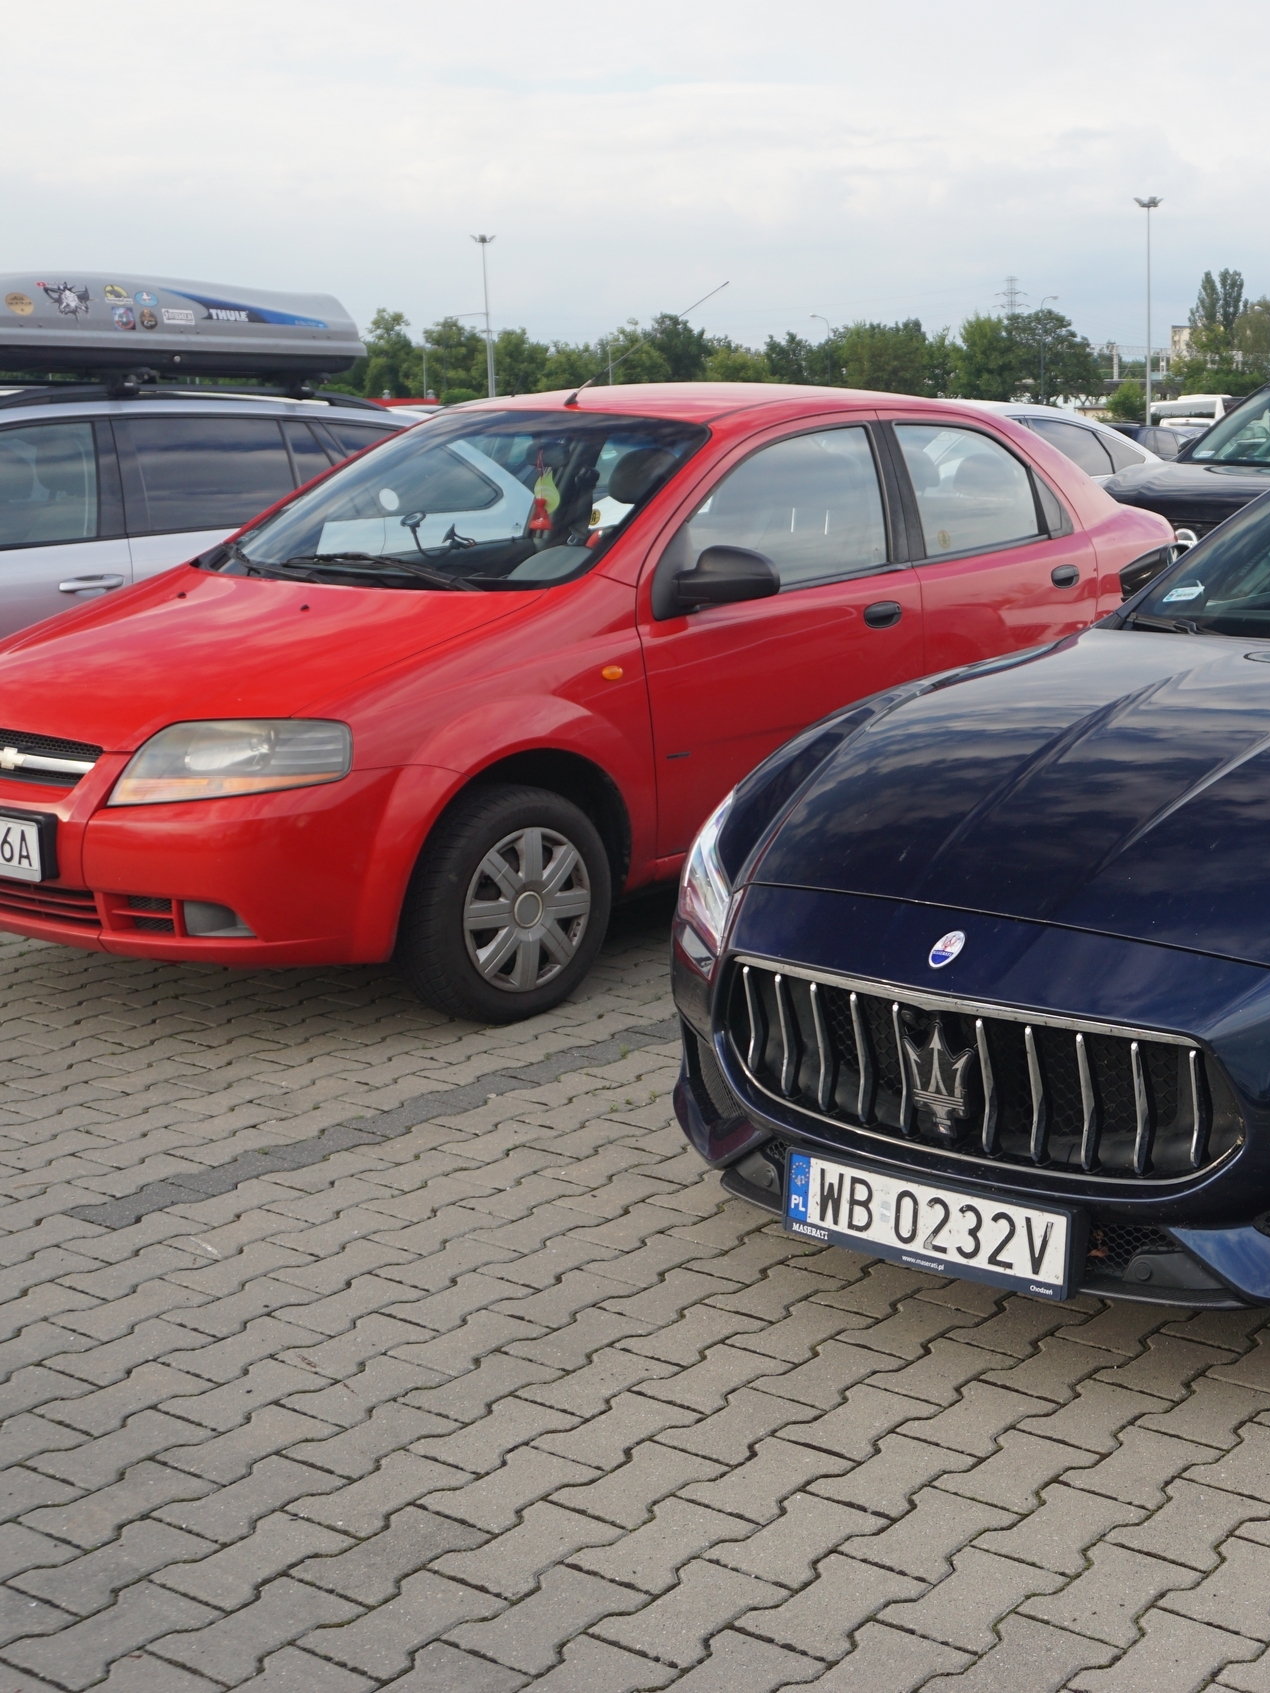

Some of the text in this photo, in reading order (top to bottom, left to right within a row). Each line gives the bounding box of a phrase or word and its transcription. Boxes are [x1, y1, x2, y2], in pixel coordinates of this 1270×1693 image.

[209, 308, 249, 321] THULE
[0, 826, 33, 867] 6A
[791, 1194, 806, 1212] PL
[819, 1167, 1054, 1276] WB 0232V
[792, 1222, 829, 1240] MASERATI
[901, 1255, 945, 1271] www.maserati.pl
